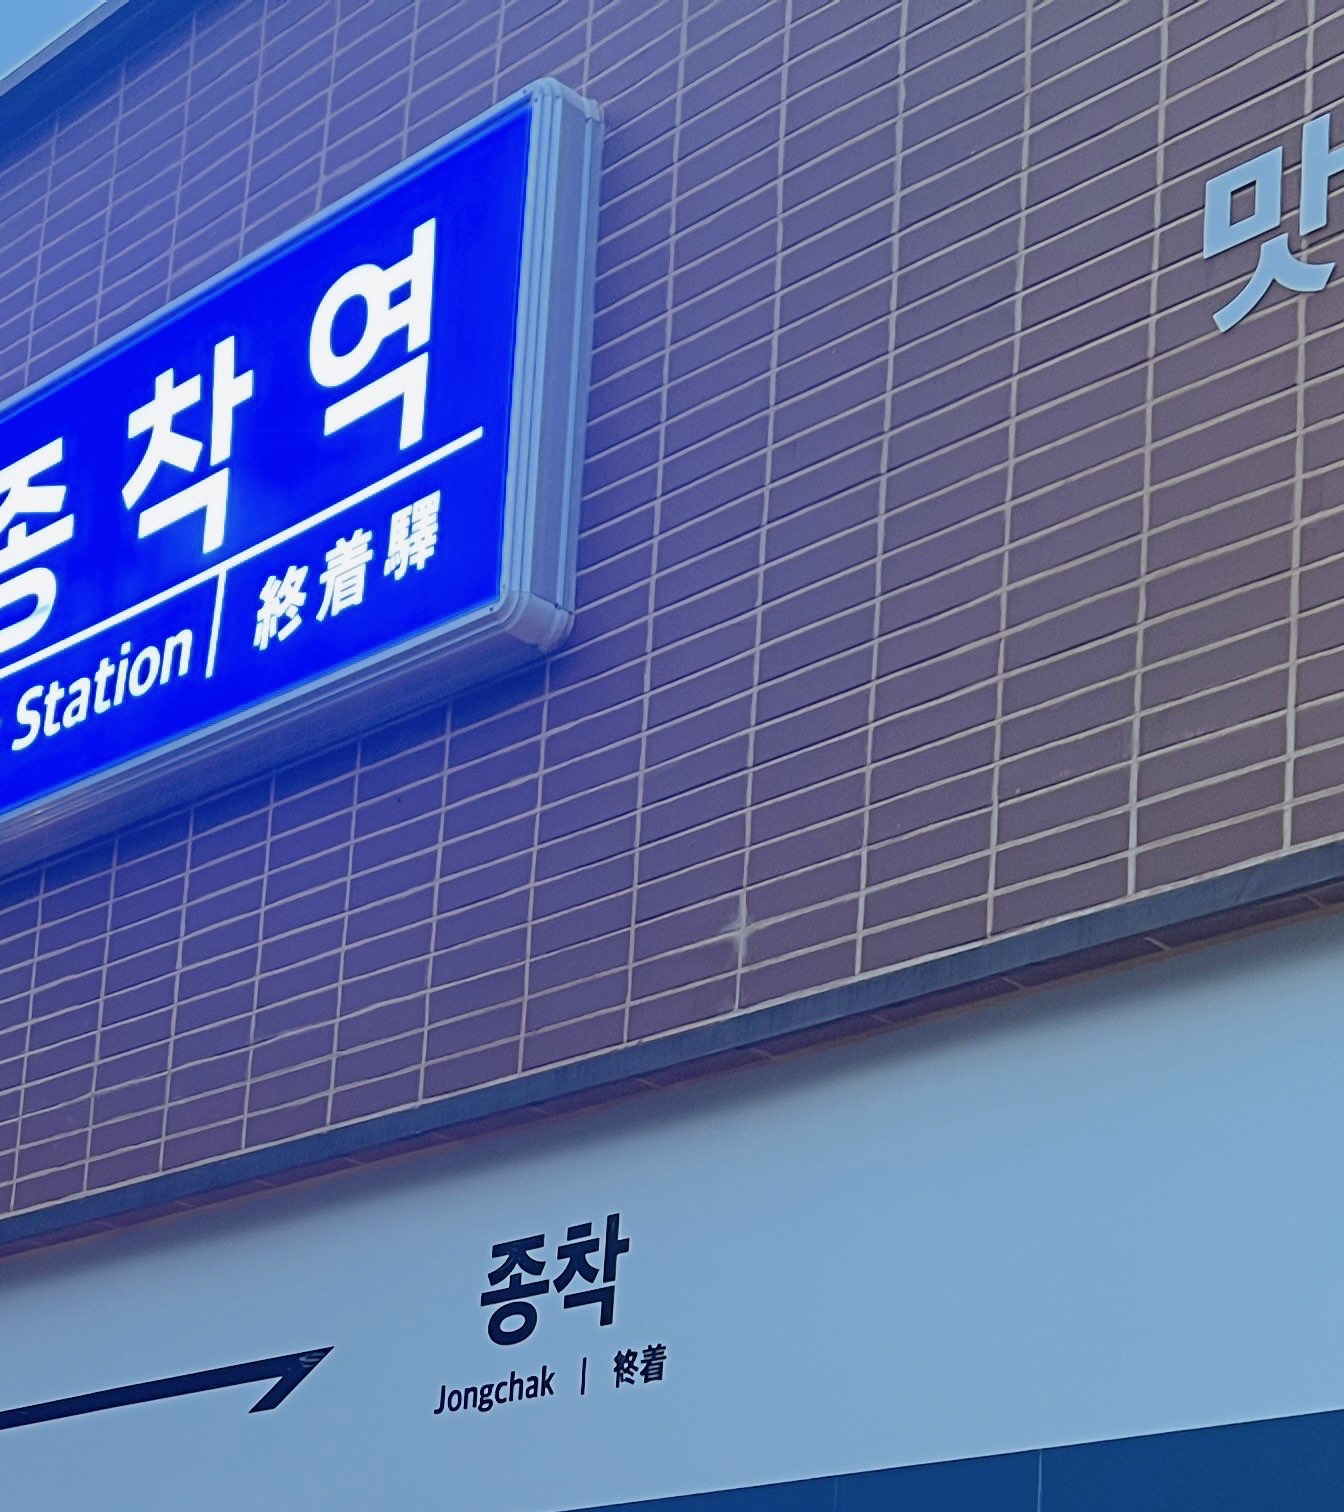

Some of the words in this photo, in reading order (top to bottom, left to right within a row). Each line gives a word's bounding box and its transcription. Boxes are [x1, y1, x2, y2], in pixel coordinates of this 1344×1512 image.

[253, 489, 442, 652] 終着驛
[11, 626, 193, 752] Station
[480, 1211, 630, 1346] 종착
[433, 1364, 556, 1415] Jongchak
